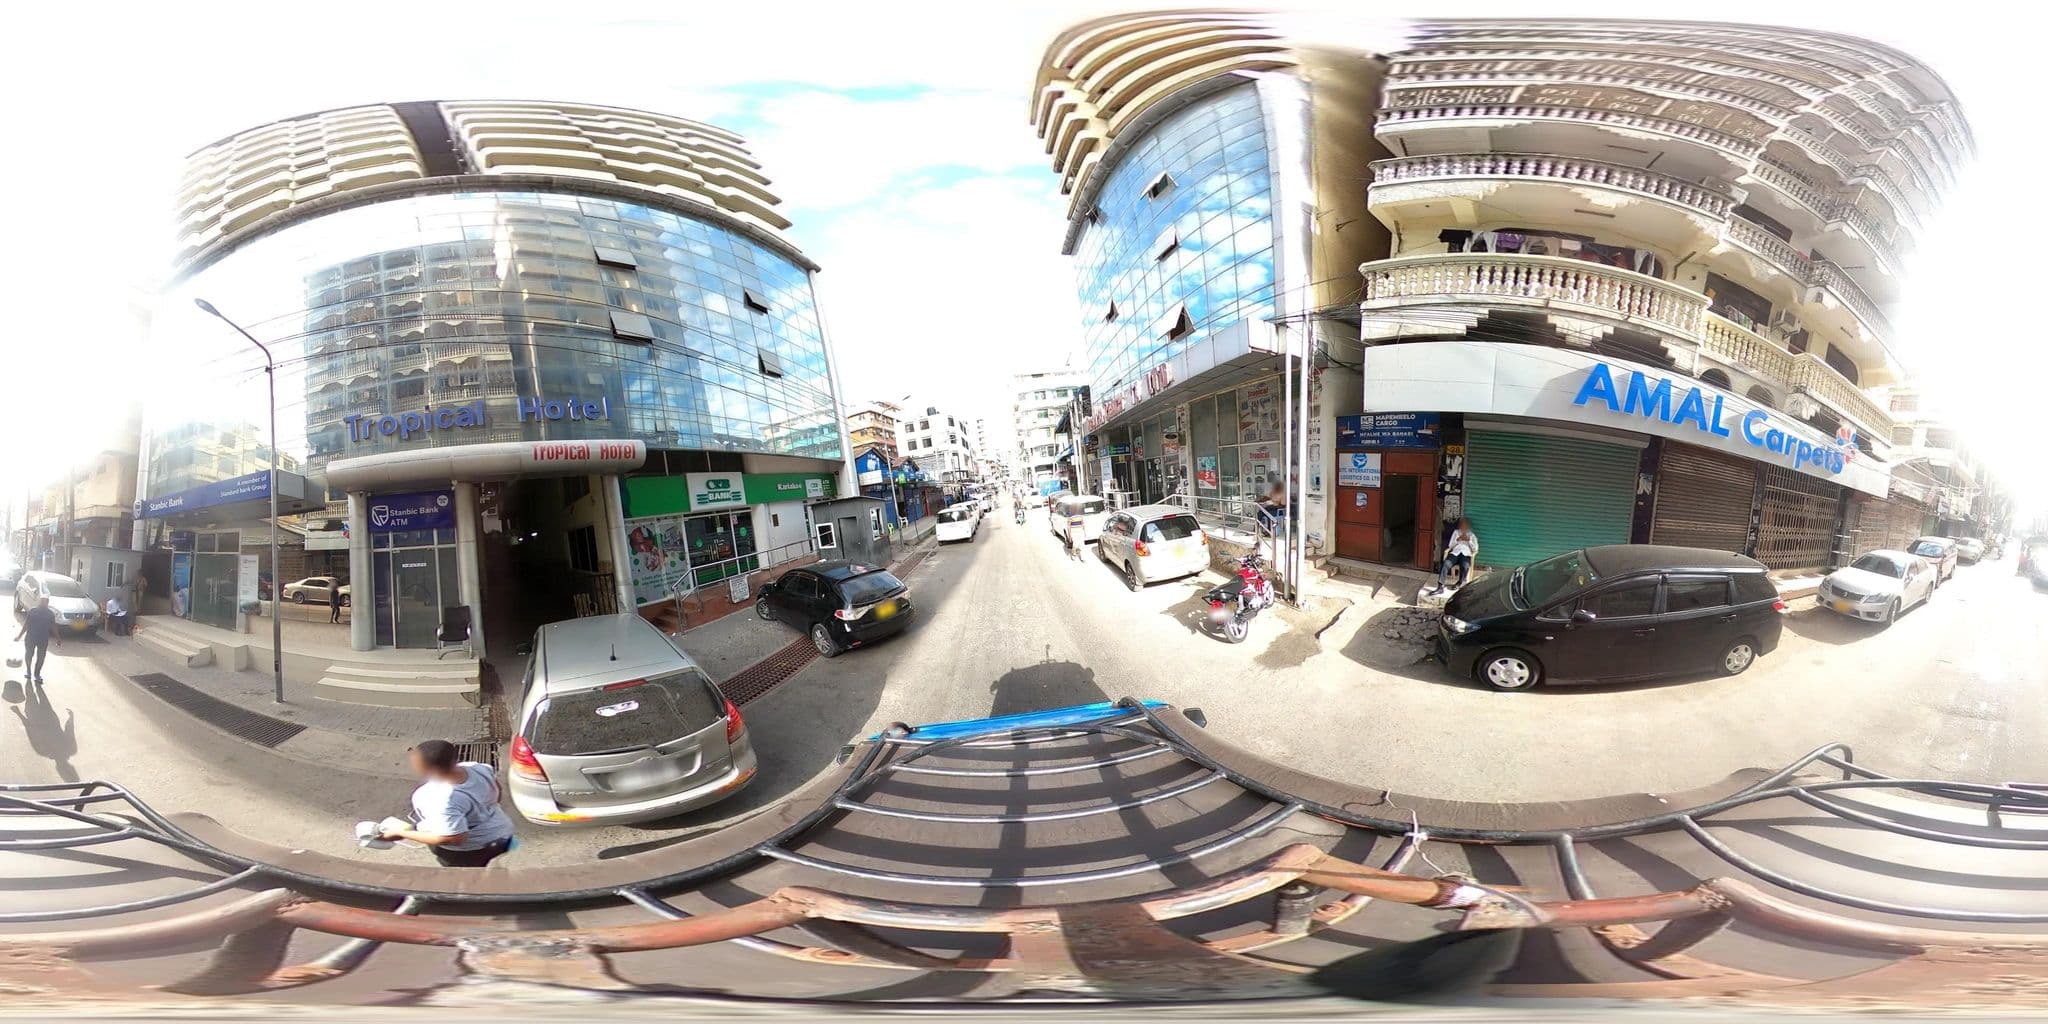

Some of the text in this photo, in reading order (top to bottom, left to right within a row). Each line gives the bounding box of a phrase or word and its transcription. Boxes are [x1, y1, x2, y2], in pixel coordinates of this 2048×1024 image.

[343, 396, 613, 443] Tropical Hotel
[1573, 363, 1844, 475] AMAL Carpets
[532, 444, 637, 461] Tropical Hotel
[709, 491, 731, 501] BANK
[149, 498, 184, 511] Stanbic Bank
[390, 506, 440, 517] Stanbic Bank
[390, 518, 408, 527] ATM
